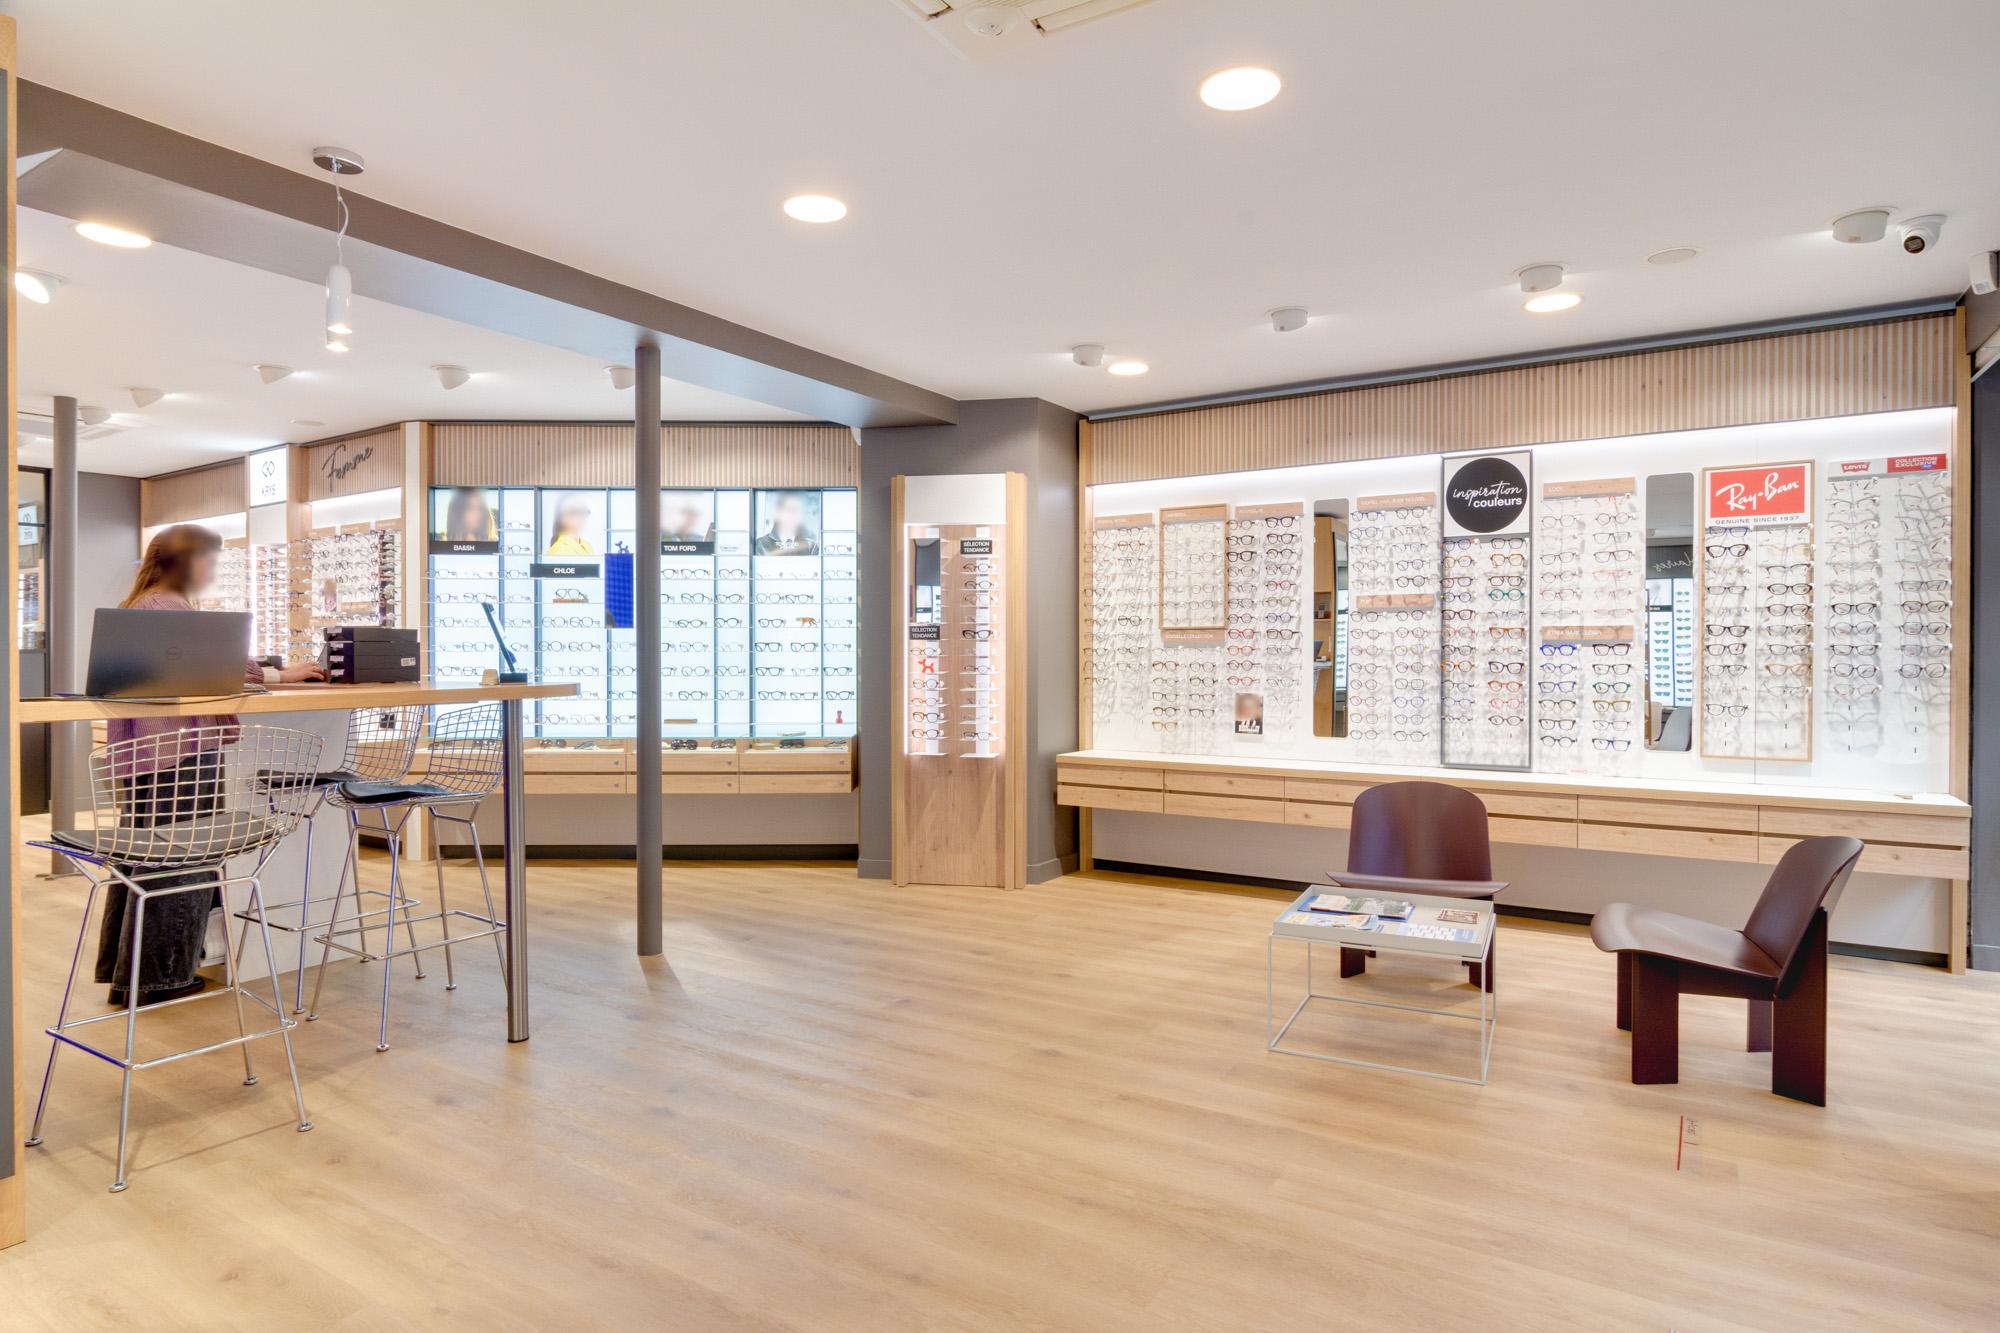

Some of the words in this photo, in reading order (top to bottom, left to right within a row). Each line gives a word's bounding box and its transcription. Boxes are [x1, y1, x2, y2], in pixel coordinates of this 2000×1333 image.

[321, 444, 374, 493] Femme
[1895, 456, 1938, 465] COLLECTION
[1452, 480, 1523, 507] inspiration
[1715, 472, 1800, 511] Ray-Ban
[1473, 497, 1523, 508] couleurs
[1715, 517, 1750, 525] GENUINE
